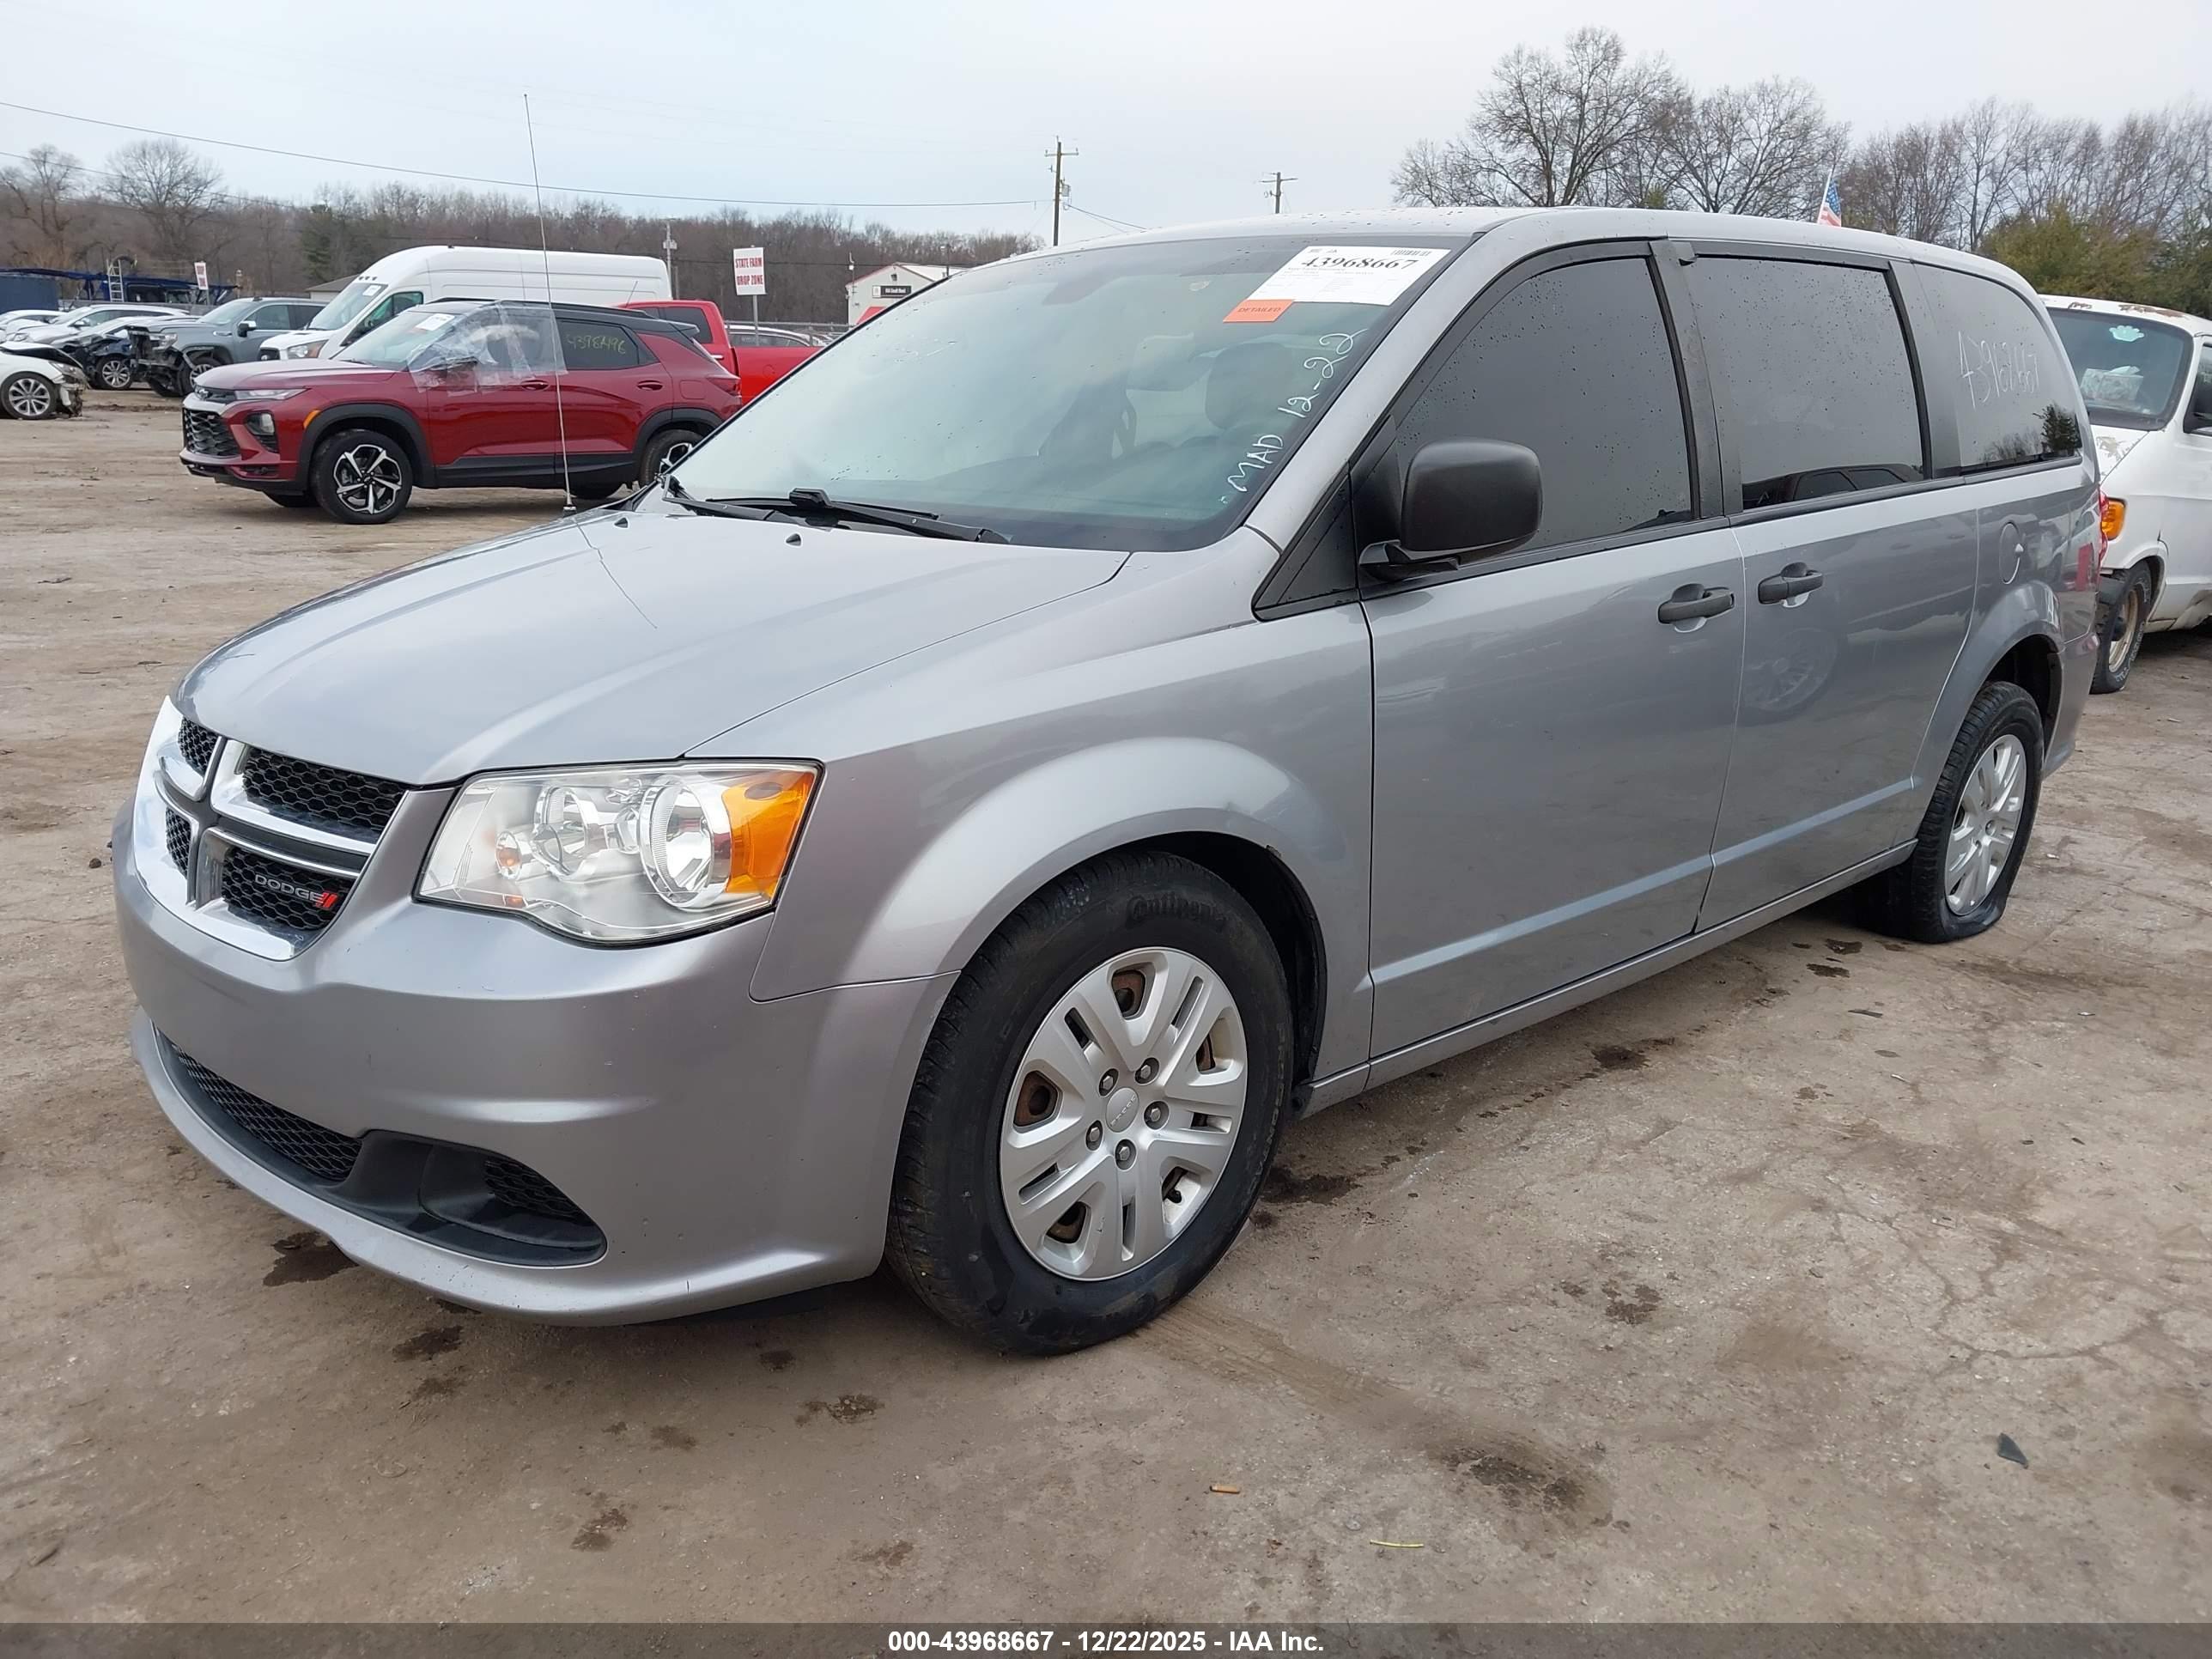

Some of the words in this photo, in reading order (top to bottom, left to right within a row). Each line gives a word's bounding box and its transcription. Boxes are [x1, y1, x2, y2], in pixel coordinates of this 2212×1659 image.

[735, 258, 749, 268] STATE
[750, 257, 763, 267] FARM
[1301, 257, 1419, 270] 43968667
[737, 276, 750, 285] DROP
[751, 275, 763, 285] ZONE
[1227, 434, 1283, 492] MAD
[1277, 328, 1368, 418] 12-22
[255, 874, 325, 904] DODGE
